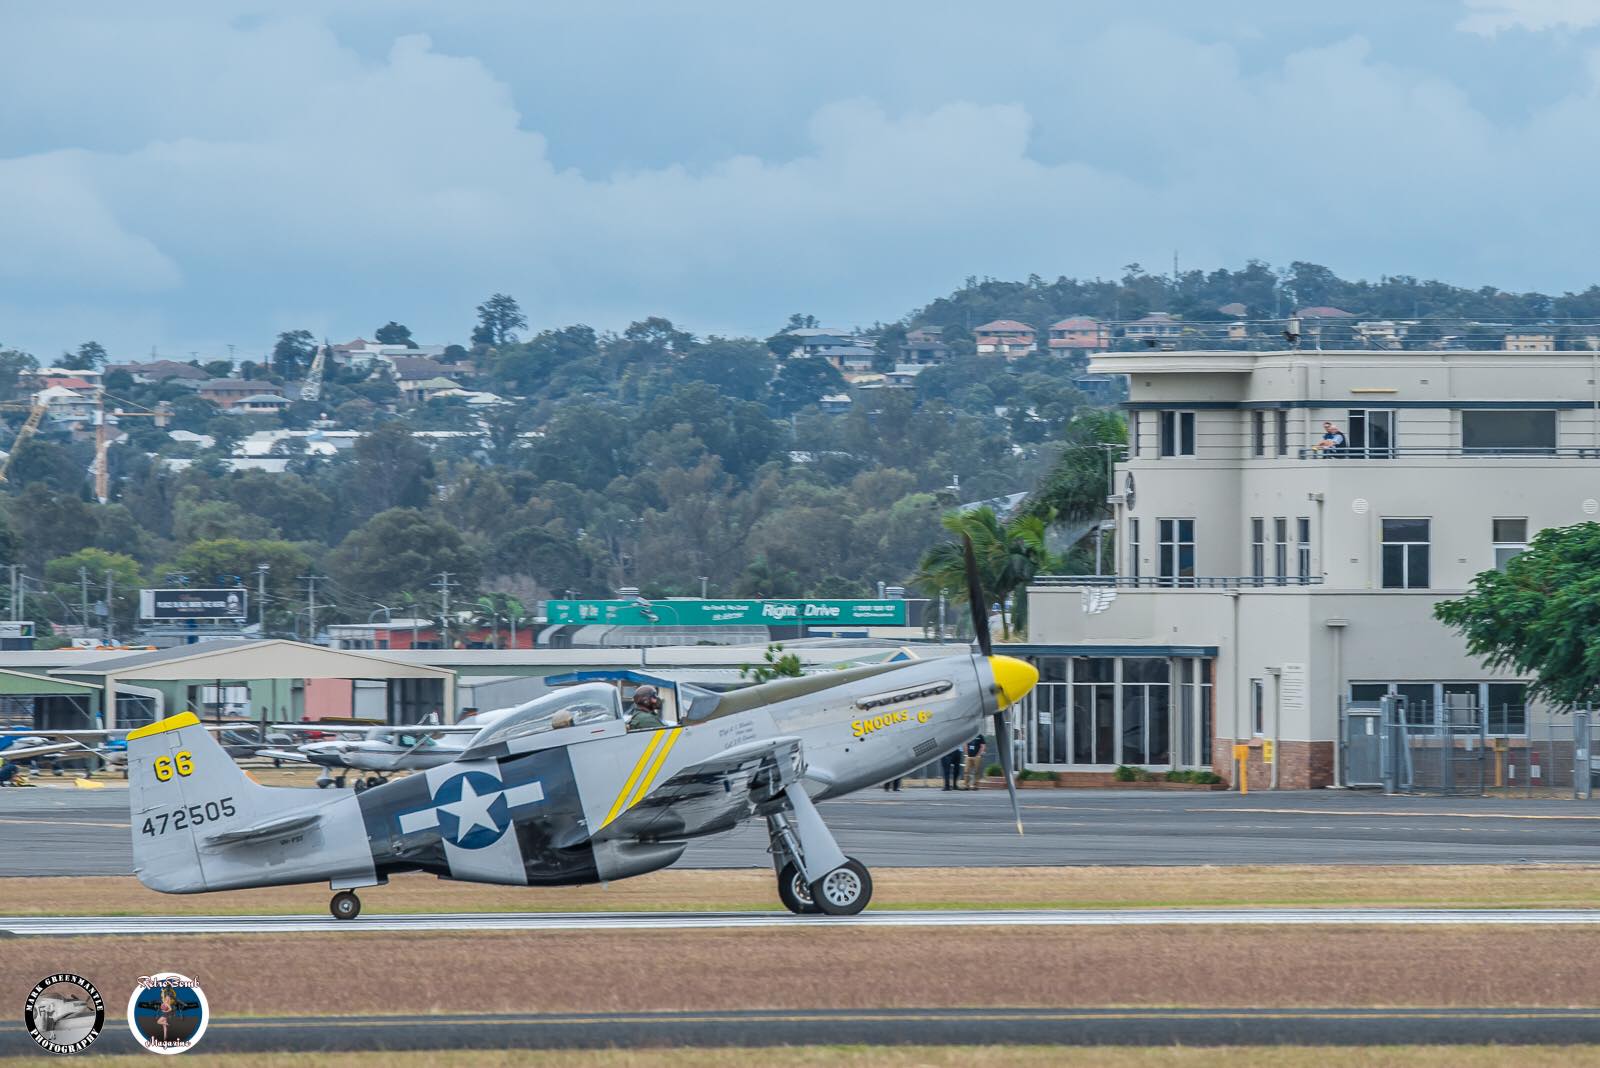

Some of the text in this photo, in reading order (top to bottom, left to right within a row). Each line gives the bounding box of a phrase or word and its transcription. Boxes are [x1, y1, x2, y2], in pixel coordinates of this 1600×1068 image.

[851, 709, 909, 737] SNOOKS
[153, 750, 195, 782] 66
[142, 797, 236, 837] 472505
